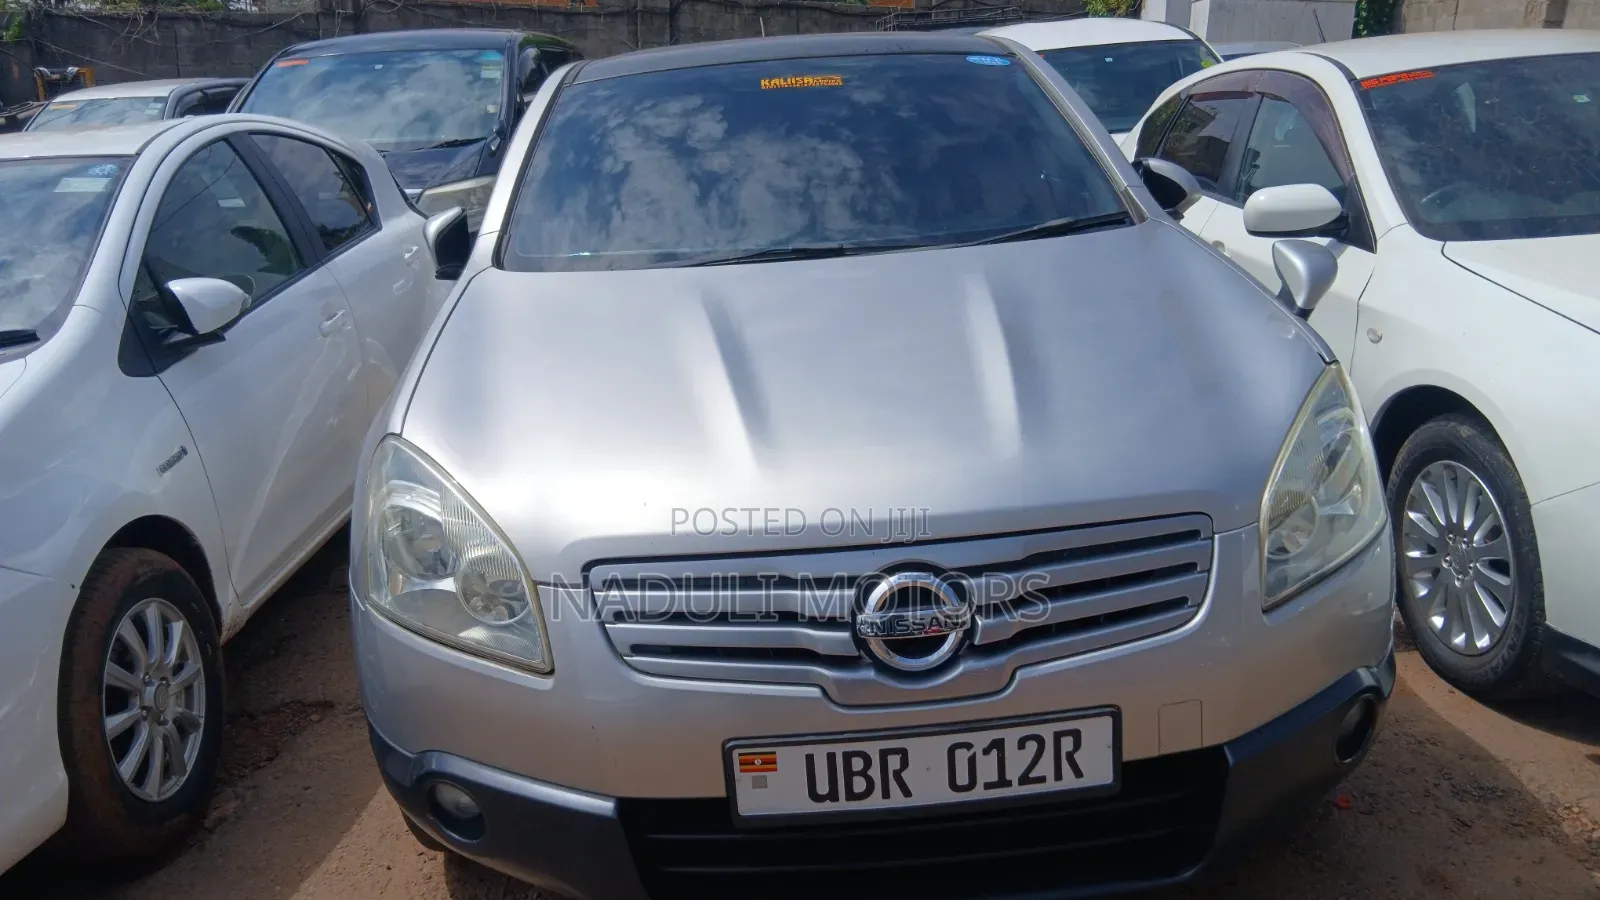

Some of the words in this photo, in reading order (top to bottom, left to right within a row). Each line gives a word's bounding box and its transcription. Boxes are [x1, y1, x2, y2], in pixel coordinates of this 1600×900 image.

[868, 613, 967, 635] NISSAN
[804, 746, 913, 804] UBR
[946, 728, 1084, 793] 012R
